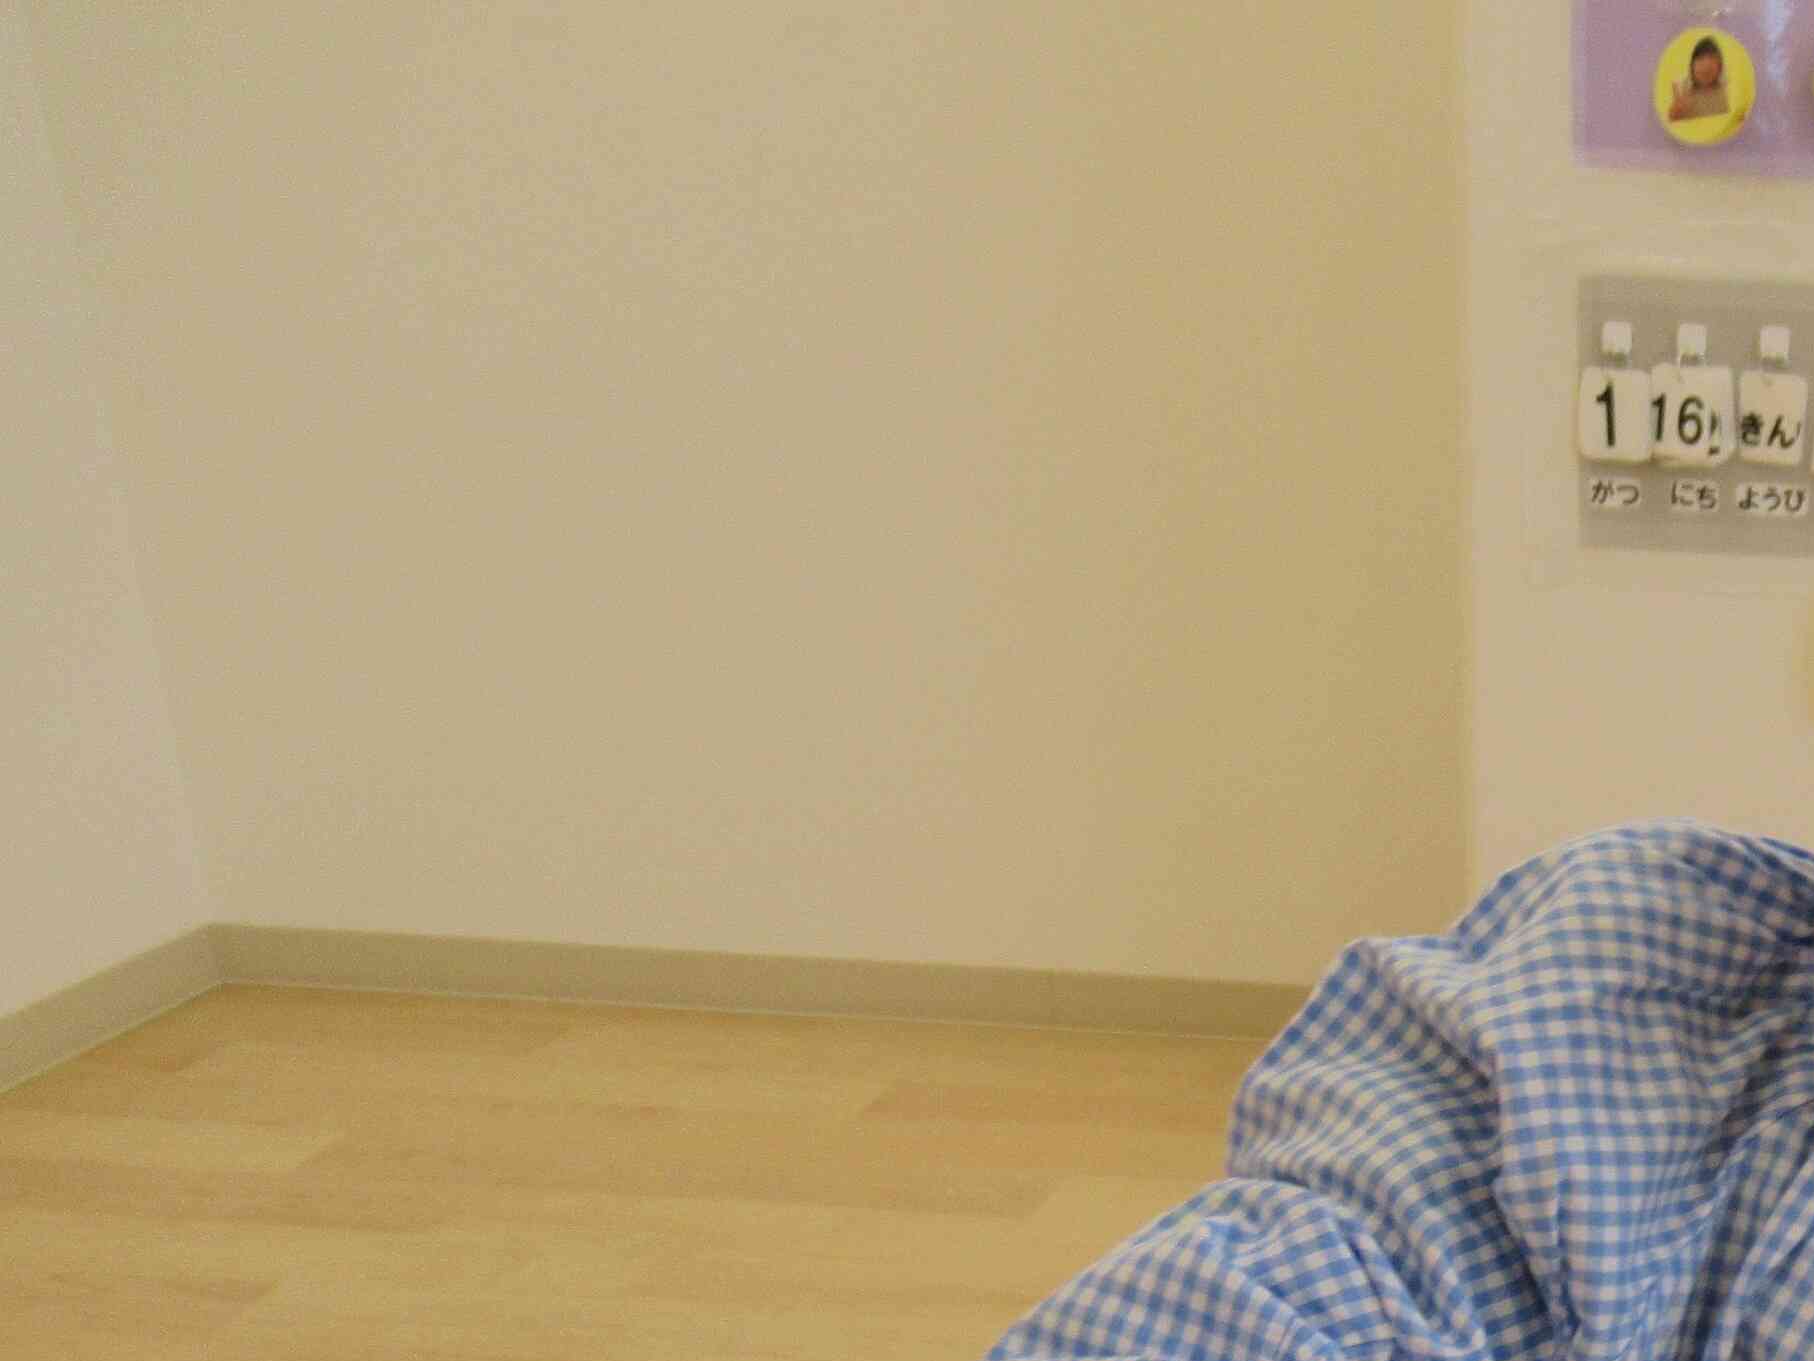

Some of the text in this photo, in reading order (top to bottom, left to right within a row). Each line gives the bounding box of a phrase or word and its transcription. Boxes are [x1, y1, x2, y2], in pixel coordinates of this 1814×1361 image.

[1595, 383, 1801, 449] 1 16 きん
[1591, 480, 1640, 505] がつ
[1670, 480, 1717, 510] にち
